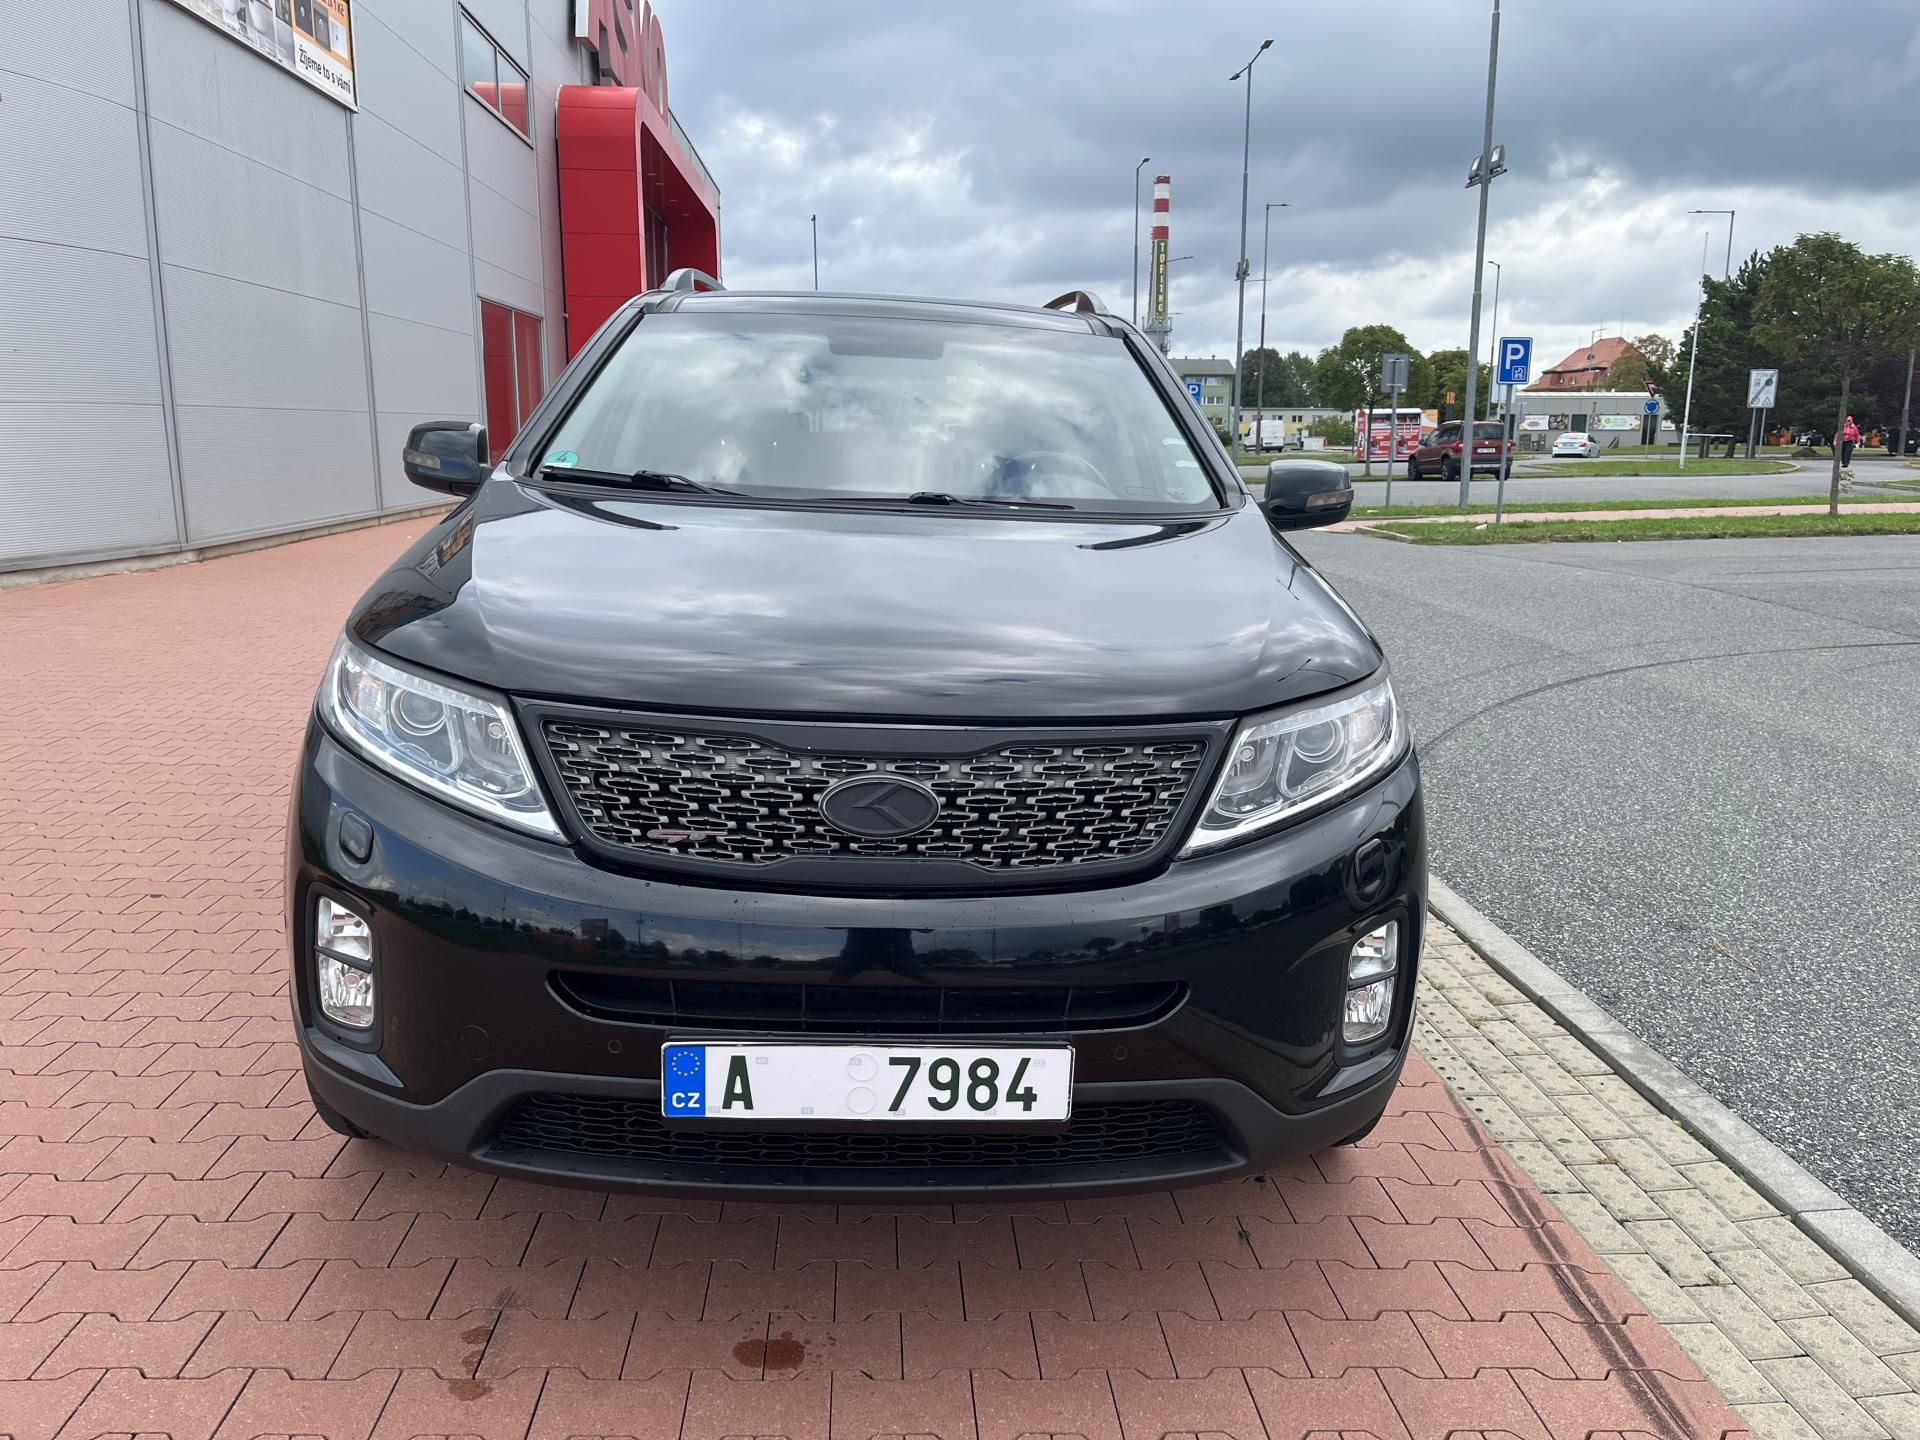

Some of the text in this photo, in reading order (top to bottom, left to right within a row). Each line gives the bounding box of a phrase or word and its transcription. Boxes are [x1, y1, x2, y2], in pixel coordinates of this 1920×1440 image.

[299, 44, 322, 75] Žijeme
[322, 64, 330, 80] to
[336, 74, 352, 94] vámi
[1505, 343, 1525, 370] P
[672, 1055, 1037, 1112] CZ A 7984
